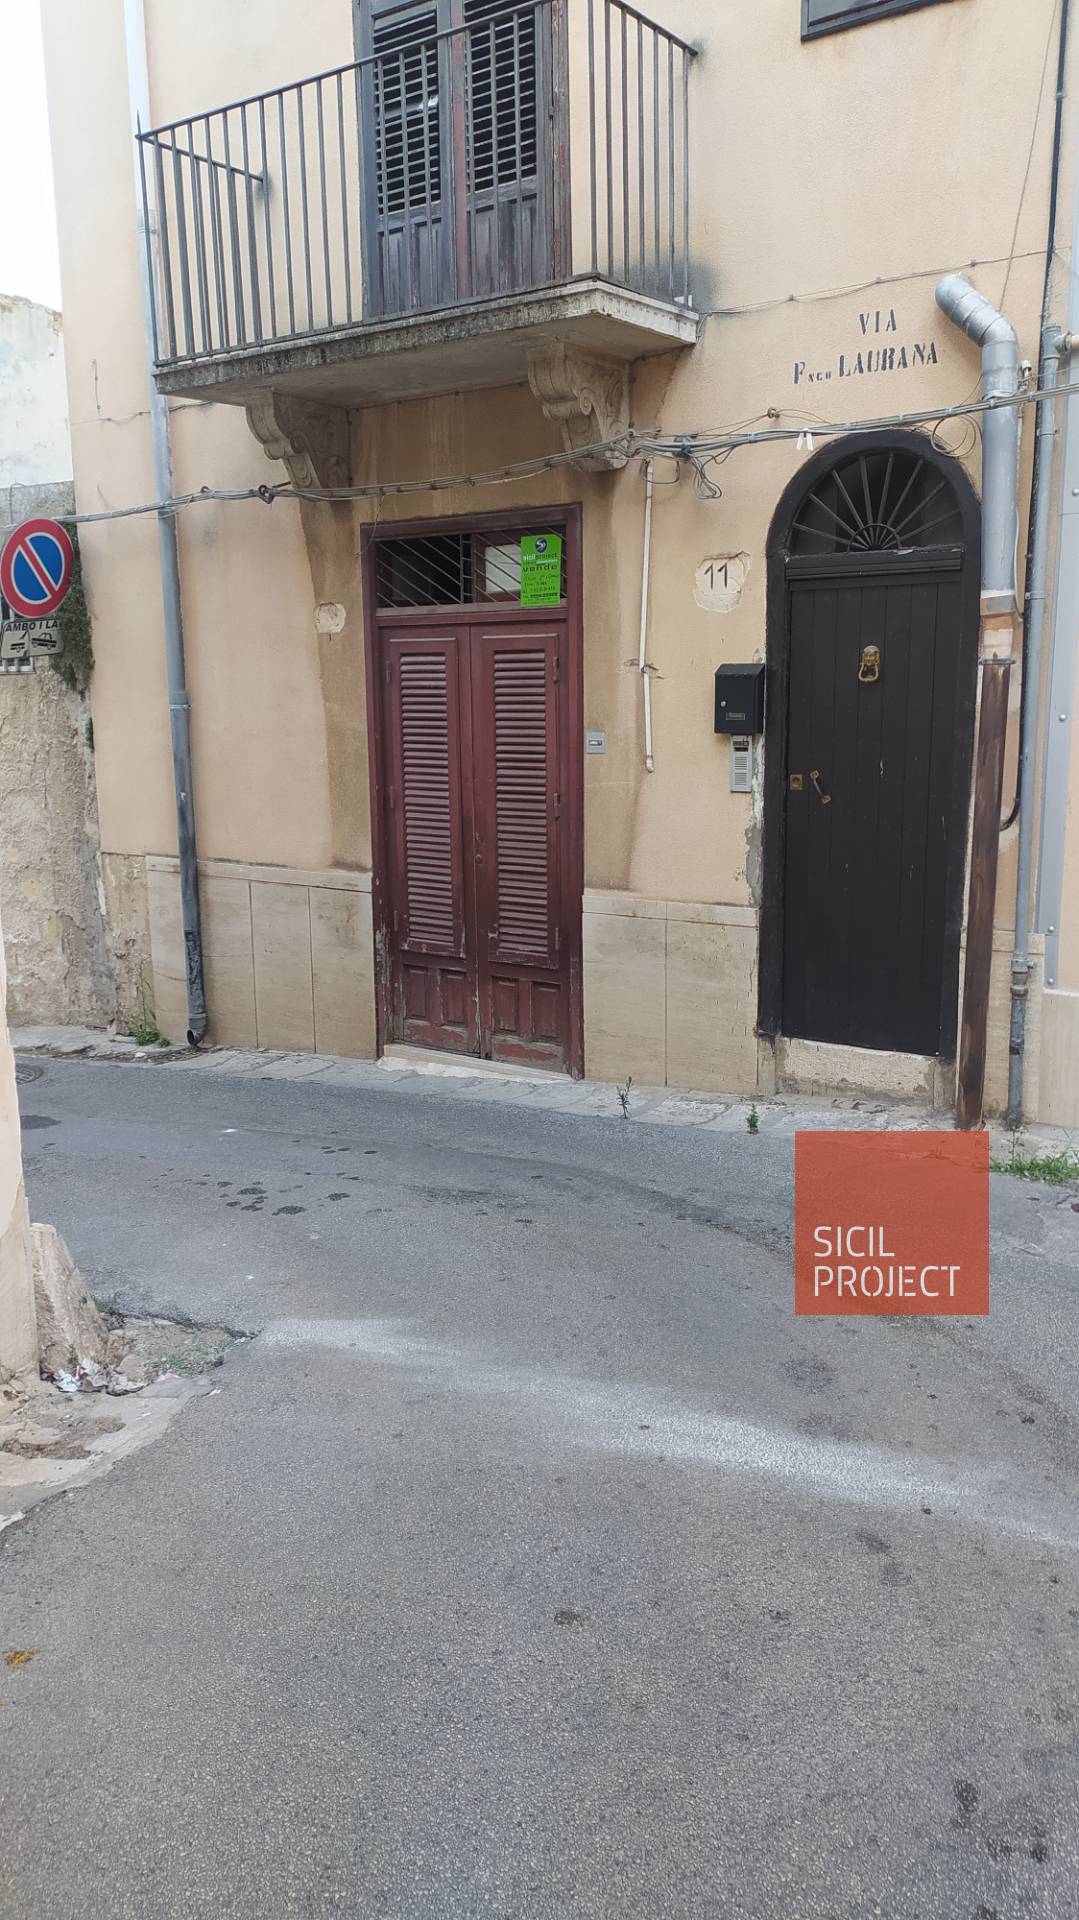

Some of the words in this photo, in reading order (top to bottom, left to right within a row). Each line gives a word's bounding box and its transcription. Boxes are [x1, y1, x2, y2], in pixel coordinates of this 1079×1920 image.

[859, 309, 897, 335] VIA
[839, 342, 938, 377] LAURANA
[523, 564, 557, 572] vende
[704, 562, 728, 590] 11
[5, 622, 36, 632] AMBO
[39, 621, 43, 630] I
